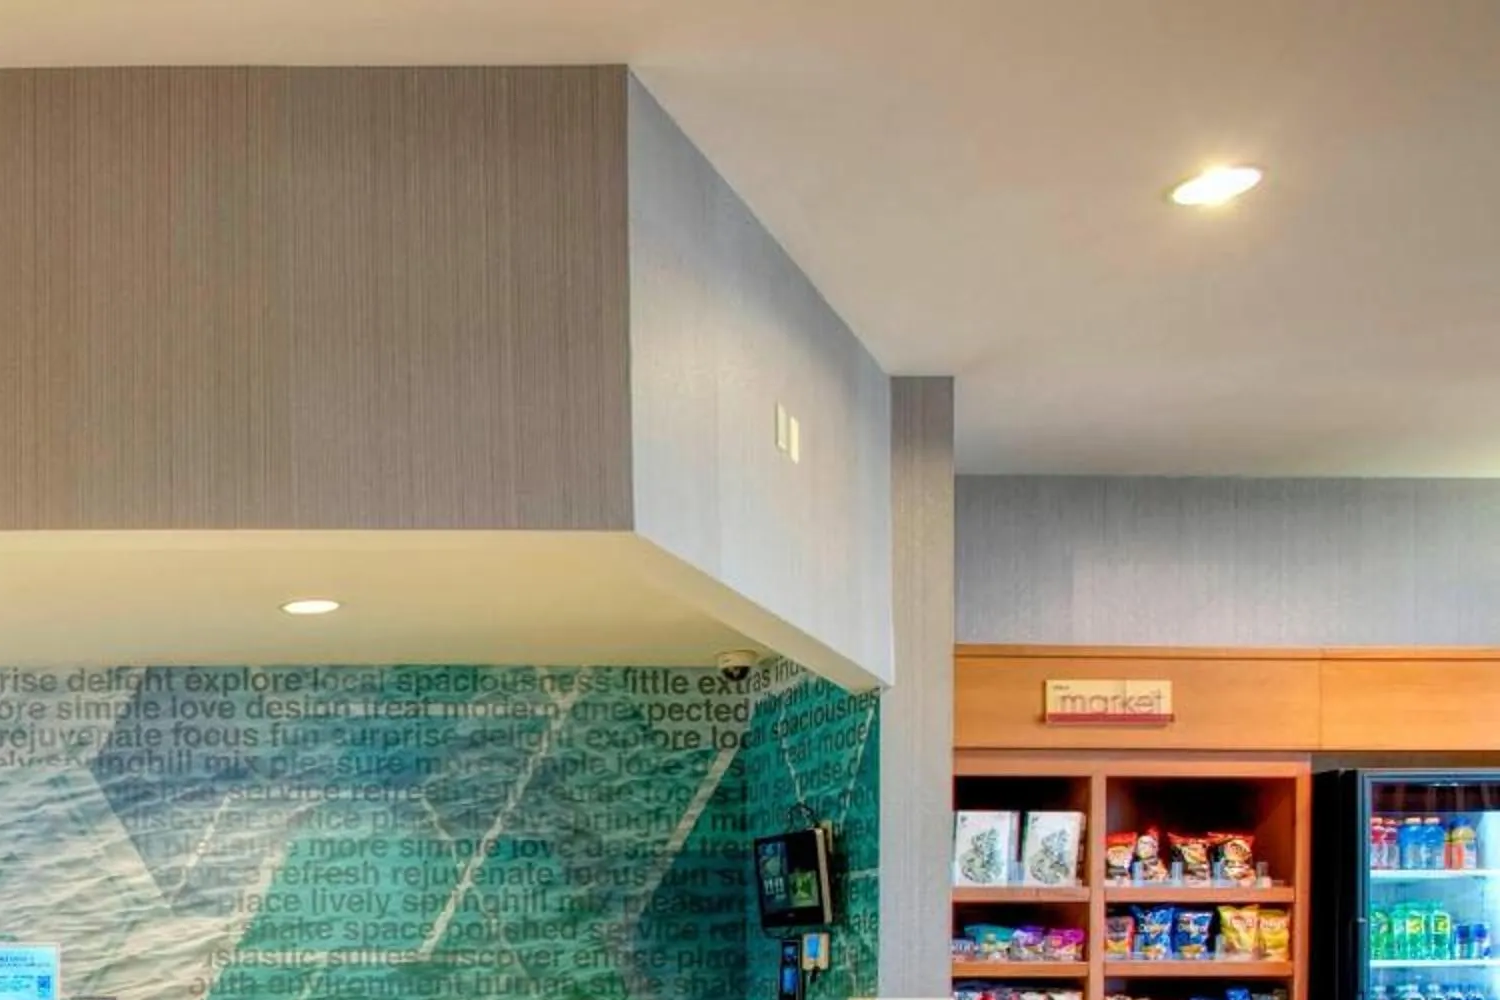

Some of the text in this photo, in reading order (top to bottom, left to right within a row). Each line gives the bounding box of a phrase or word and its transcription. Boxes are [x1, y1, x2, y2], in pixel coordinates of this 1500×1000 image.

[67, 667, 175, 698] delight
[185, 667, 303, 698] explore
[314, 667, 385, 692] local
[396, 667, 610, 698] spaciousness
[57, 696, 162, 727] simple
[172, 696, 236, 721] love
[246, 696, 350, 727] design
[365, 697, 431, 721] treat
[443, 696, 560, 721] modern
[571, 699, 750, 727] unexpected
[1060, 688, 1164, 714] market
[0, 722, 162, 754] rejuvenate
[173, 721, 259, 747] focus
[269, 722, 319, 748] fun
[332, 723, 456, 753] surprise
[585, 723, 702, 754] explore
[308, 837, 389, 859] more
[511, 834, 577, 859] love
[272, 859, 380, 887] refresh
[391, 860, 554, 894] rejuvenate
[312, 888, 391, 918] lively
[402, 887, 547, 919] springhill
[343, 918, 434, 947] space
